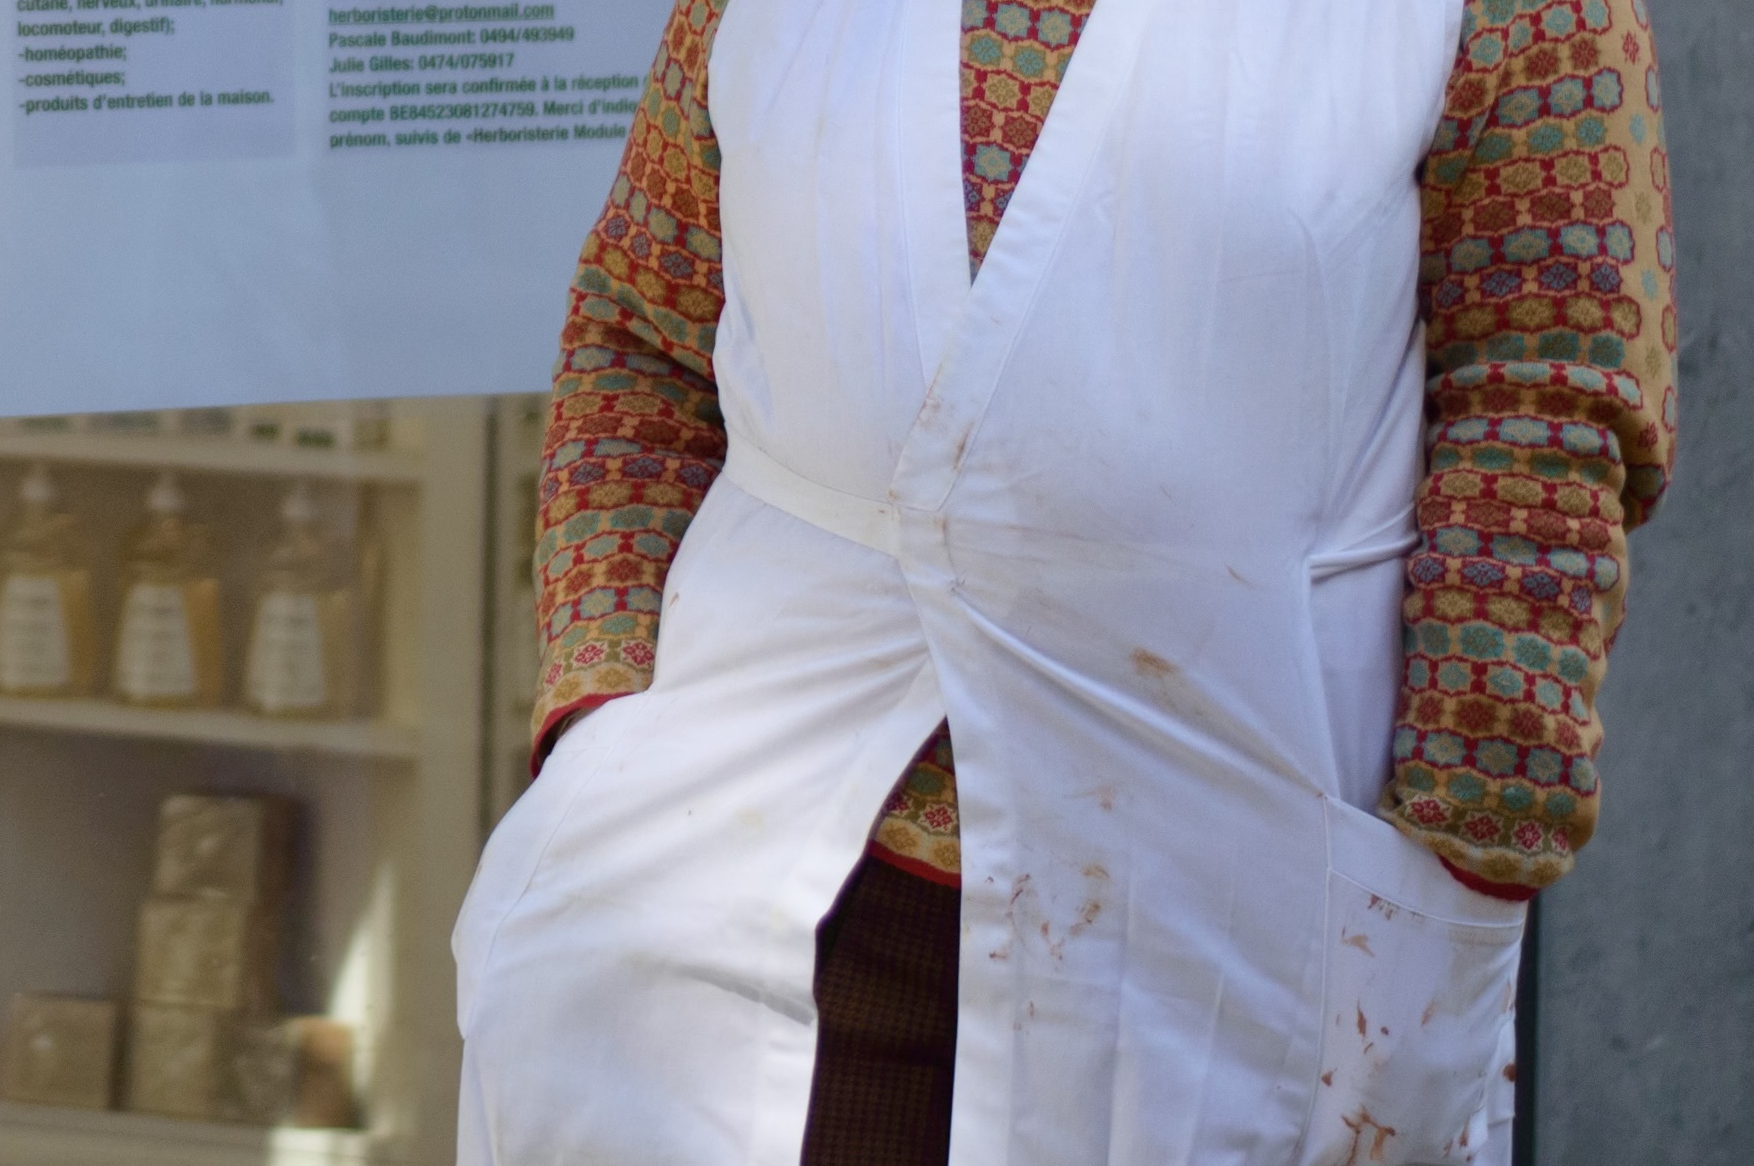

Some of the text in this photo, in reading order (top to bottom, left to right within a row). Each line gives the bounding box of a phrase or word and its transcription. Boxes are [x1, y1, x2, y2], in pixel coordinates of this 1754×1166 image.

[329, 33, 386, 48] Pascale
[329, 57, 365, 72] Julie
[19, 96, 88, 114] -produits
[92, 94, 173, 109] d'entretien
[177, 92, 195, 106] de
[199, 91, 213, 106] la
